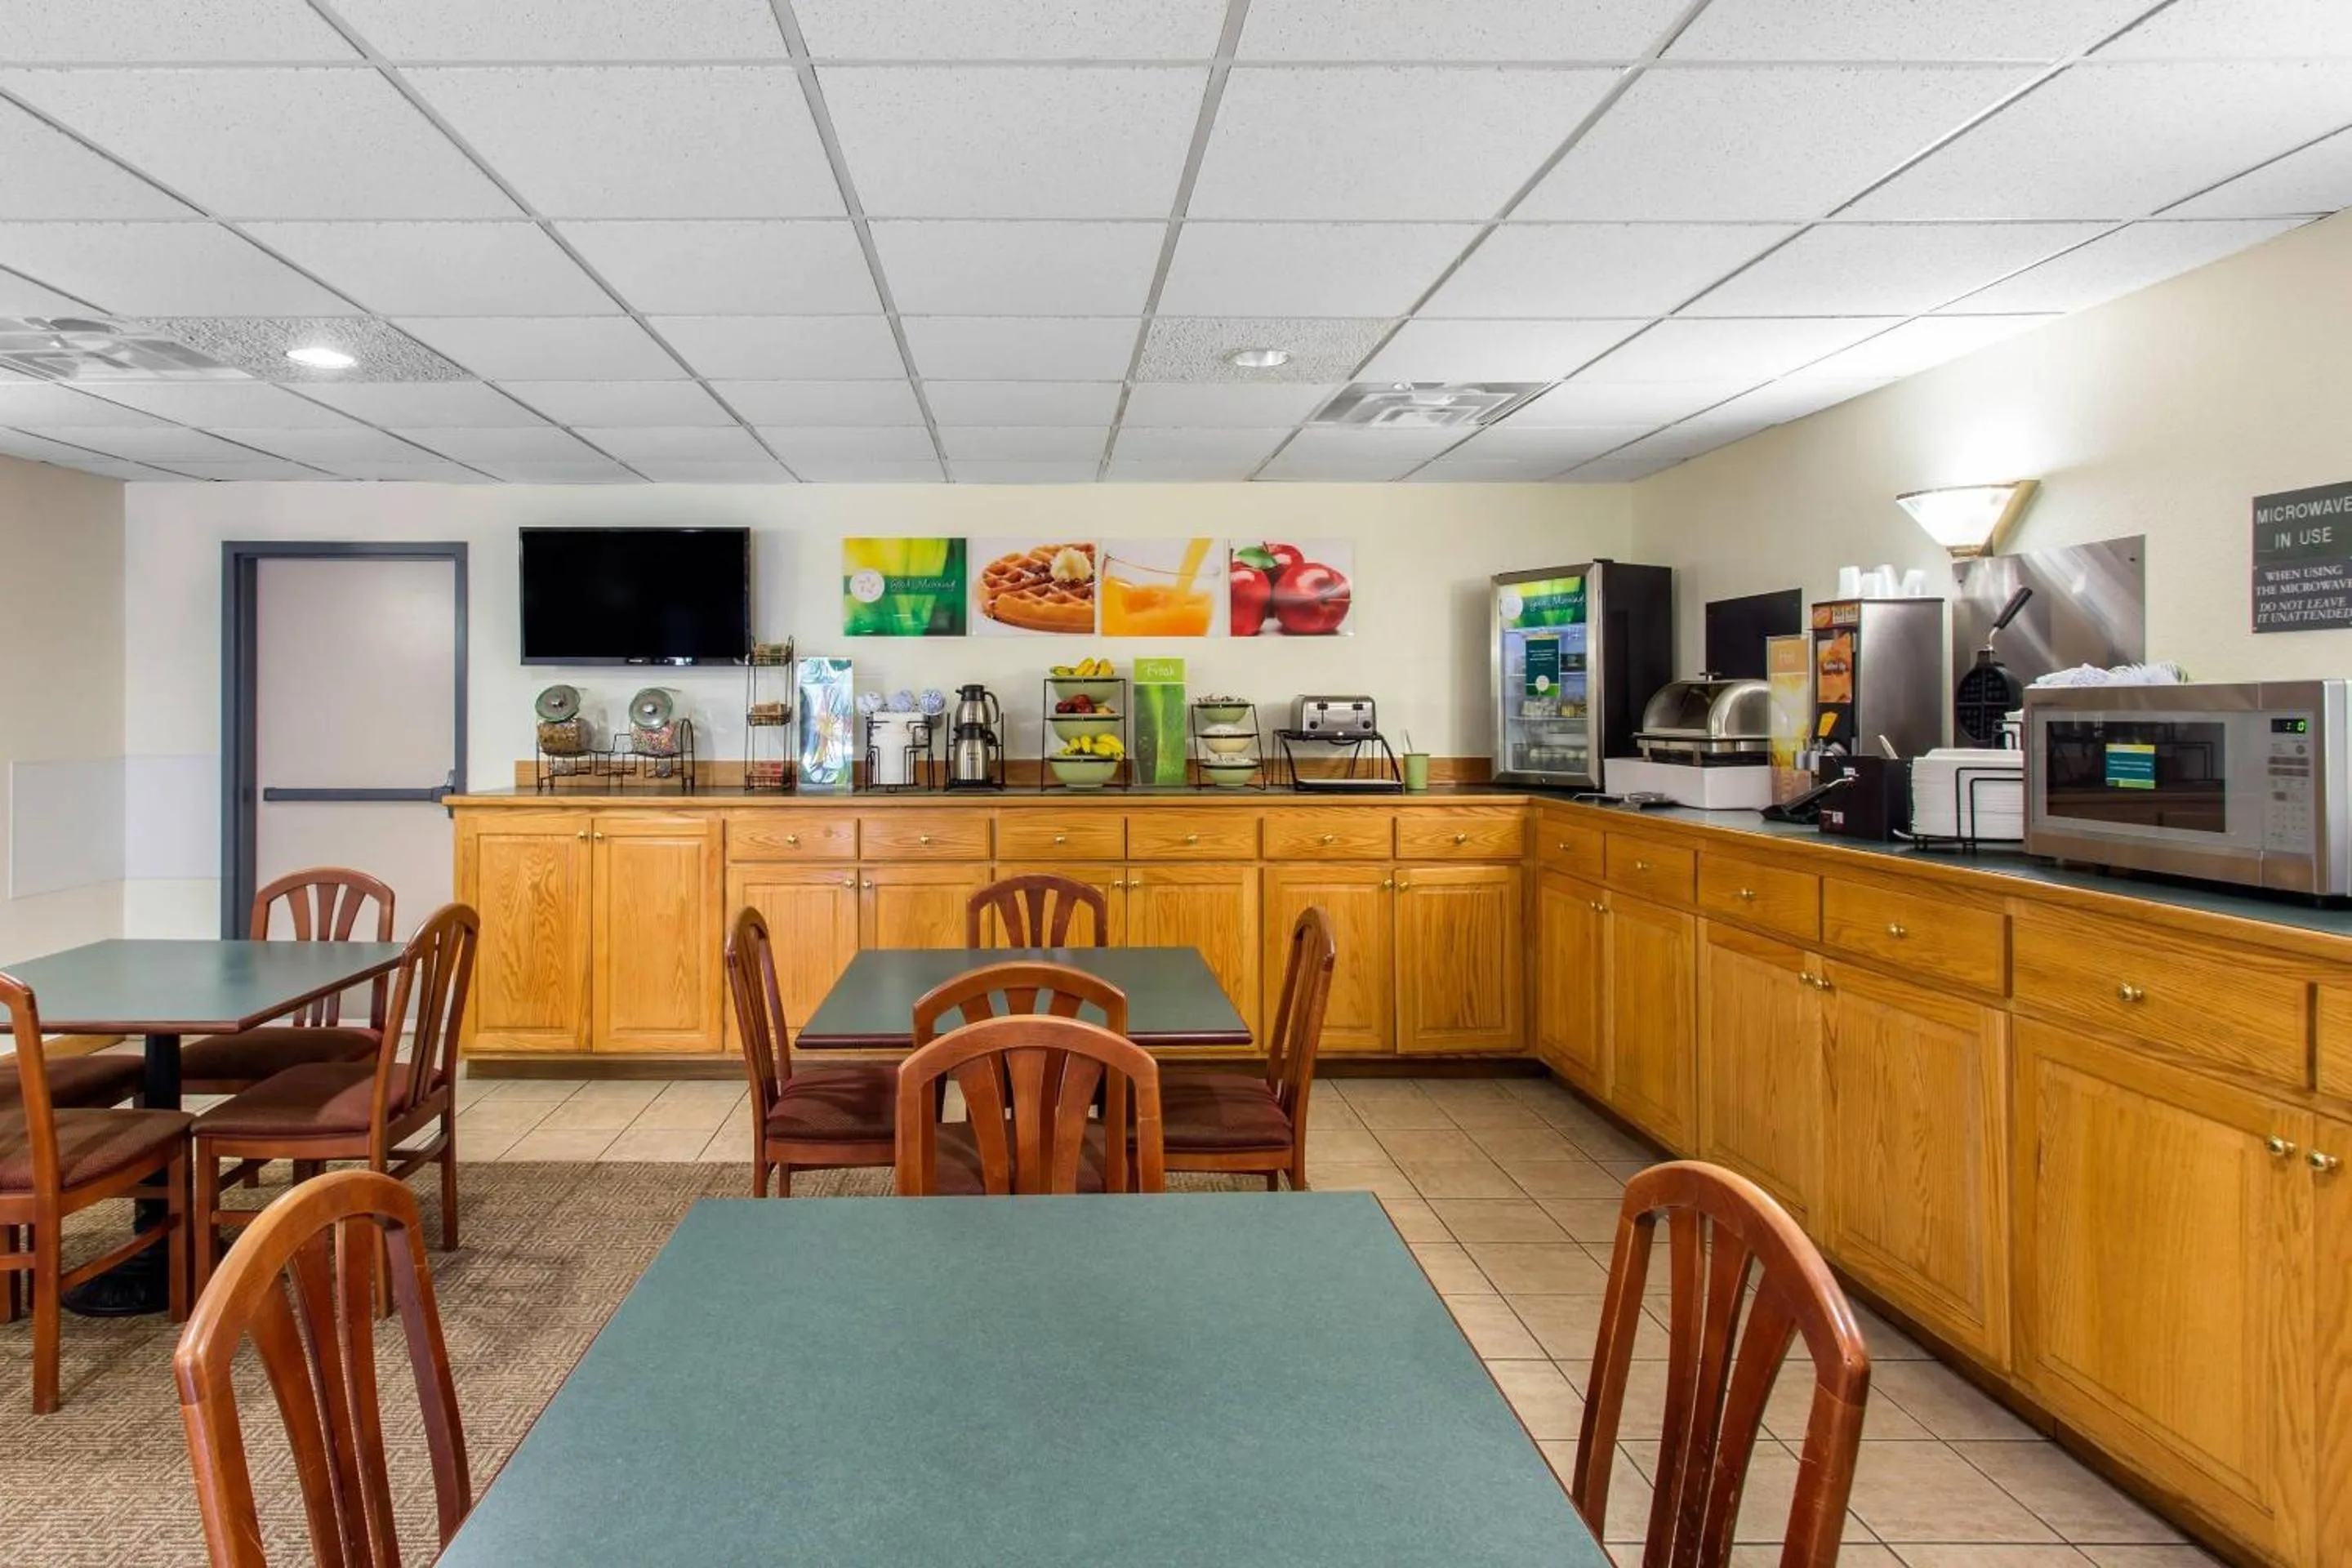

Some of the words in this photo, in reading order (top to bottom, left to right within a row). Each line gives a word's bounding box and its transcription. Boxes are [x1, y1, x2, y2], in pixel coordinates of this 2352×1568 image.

[2256, 496, 2352, 524] MICROWAVE
[2274, 532, 2292, 549] IN
[2299, 527, 2333, 545] USE
[2265, 569, 2301, 581] WHEN
[2304, 565, 2343, 578] USING
[2256, 585, 2277, 596] THE
[2279, 578, 2352, 595] MICROWAVE
[2259, 601, 2277, 612] DO
[2279, 599, 2305, 611] NOT
[2306, 597, 2346, 609] LEAVE
[2256, 613, 2270, 623] IT
